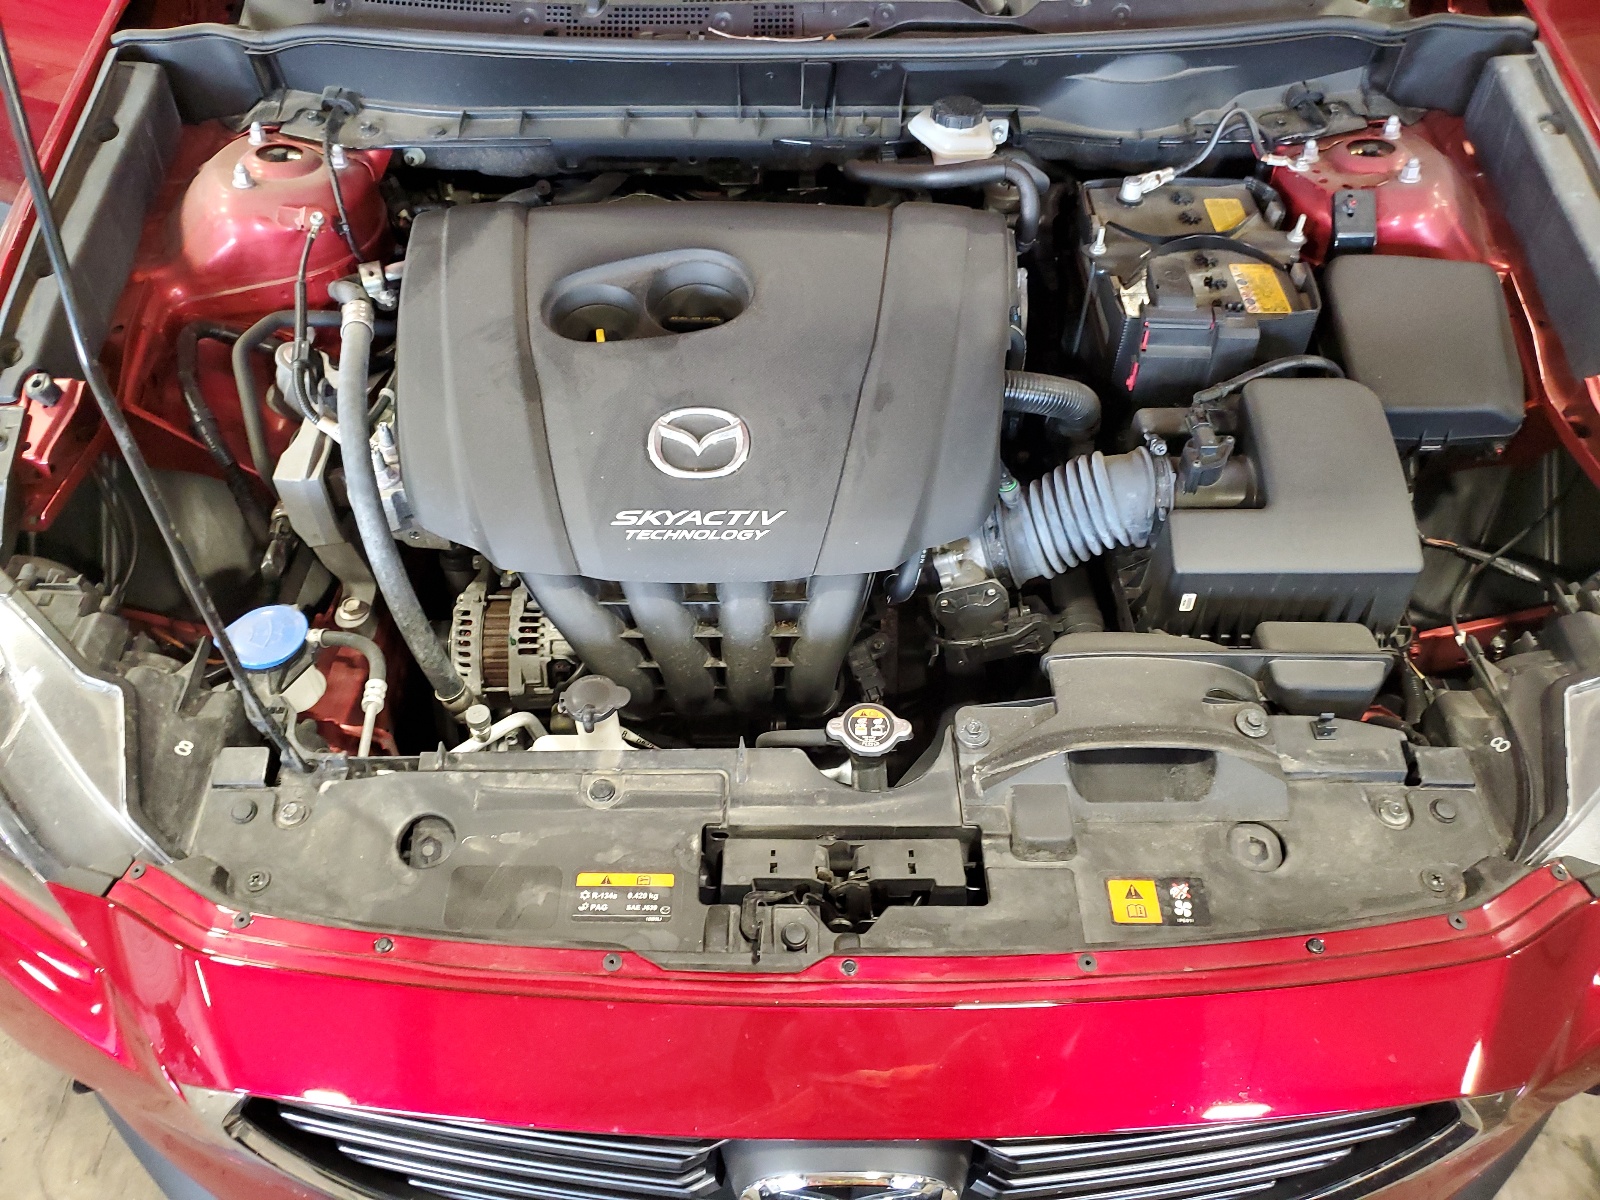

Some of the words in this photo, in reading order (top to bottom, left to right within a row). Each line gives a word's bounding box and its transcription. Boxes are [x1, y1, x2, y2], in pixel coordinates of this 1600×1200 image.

[610, 509, 788, 526] SKYACTIV
[625, 529, 771, 541] TECHNOLOGY
[173, 740, 195, 756] 8
[1490, 736, 1511, 753] 8
[591, 891, 618, 900] R-134a
[648, 892, 659, 901] kg
[589, 903, 608, 911] PAG
